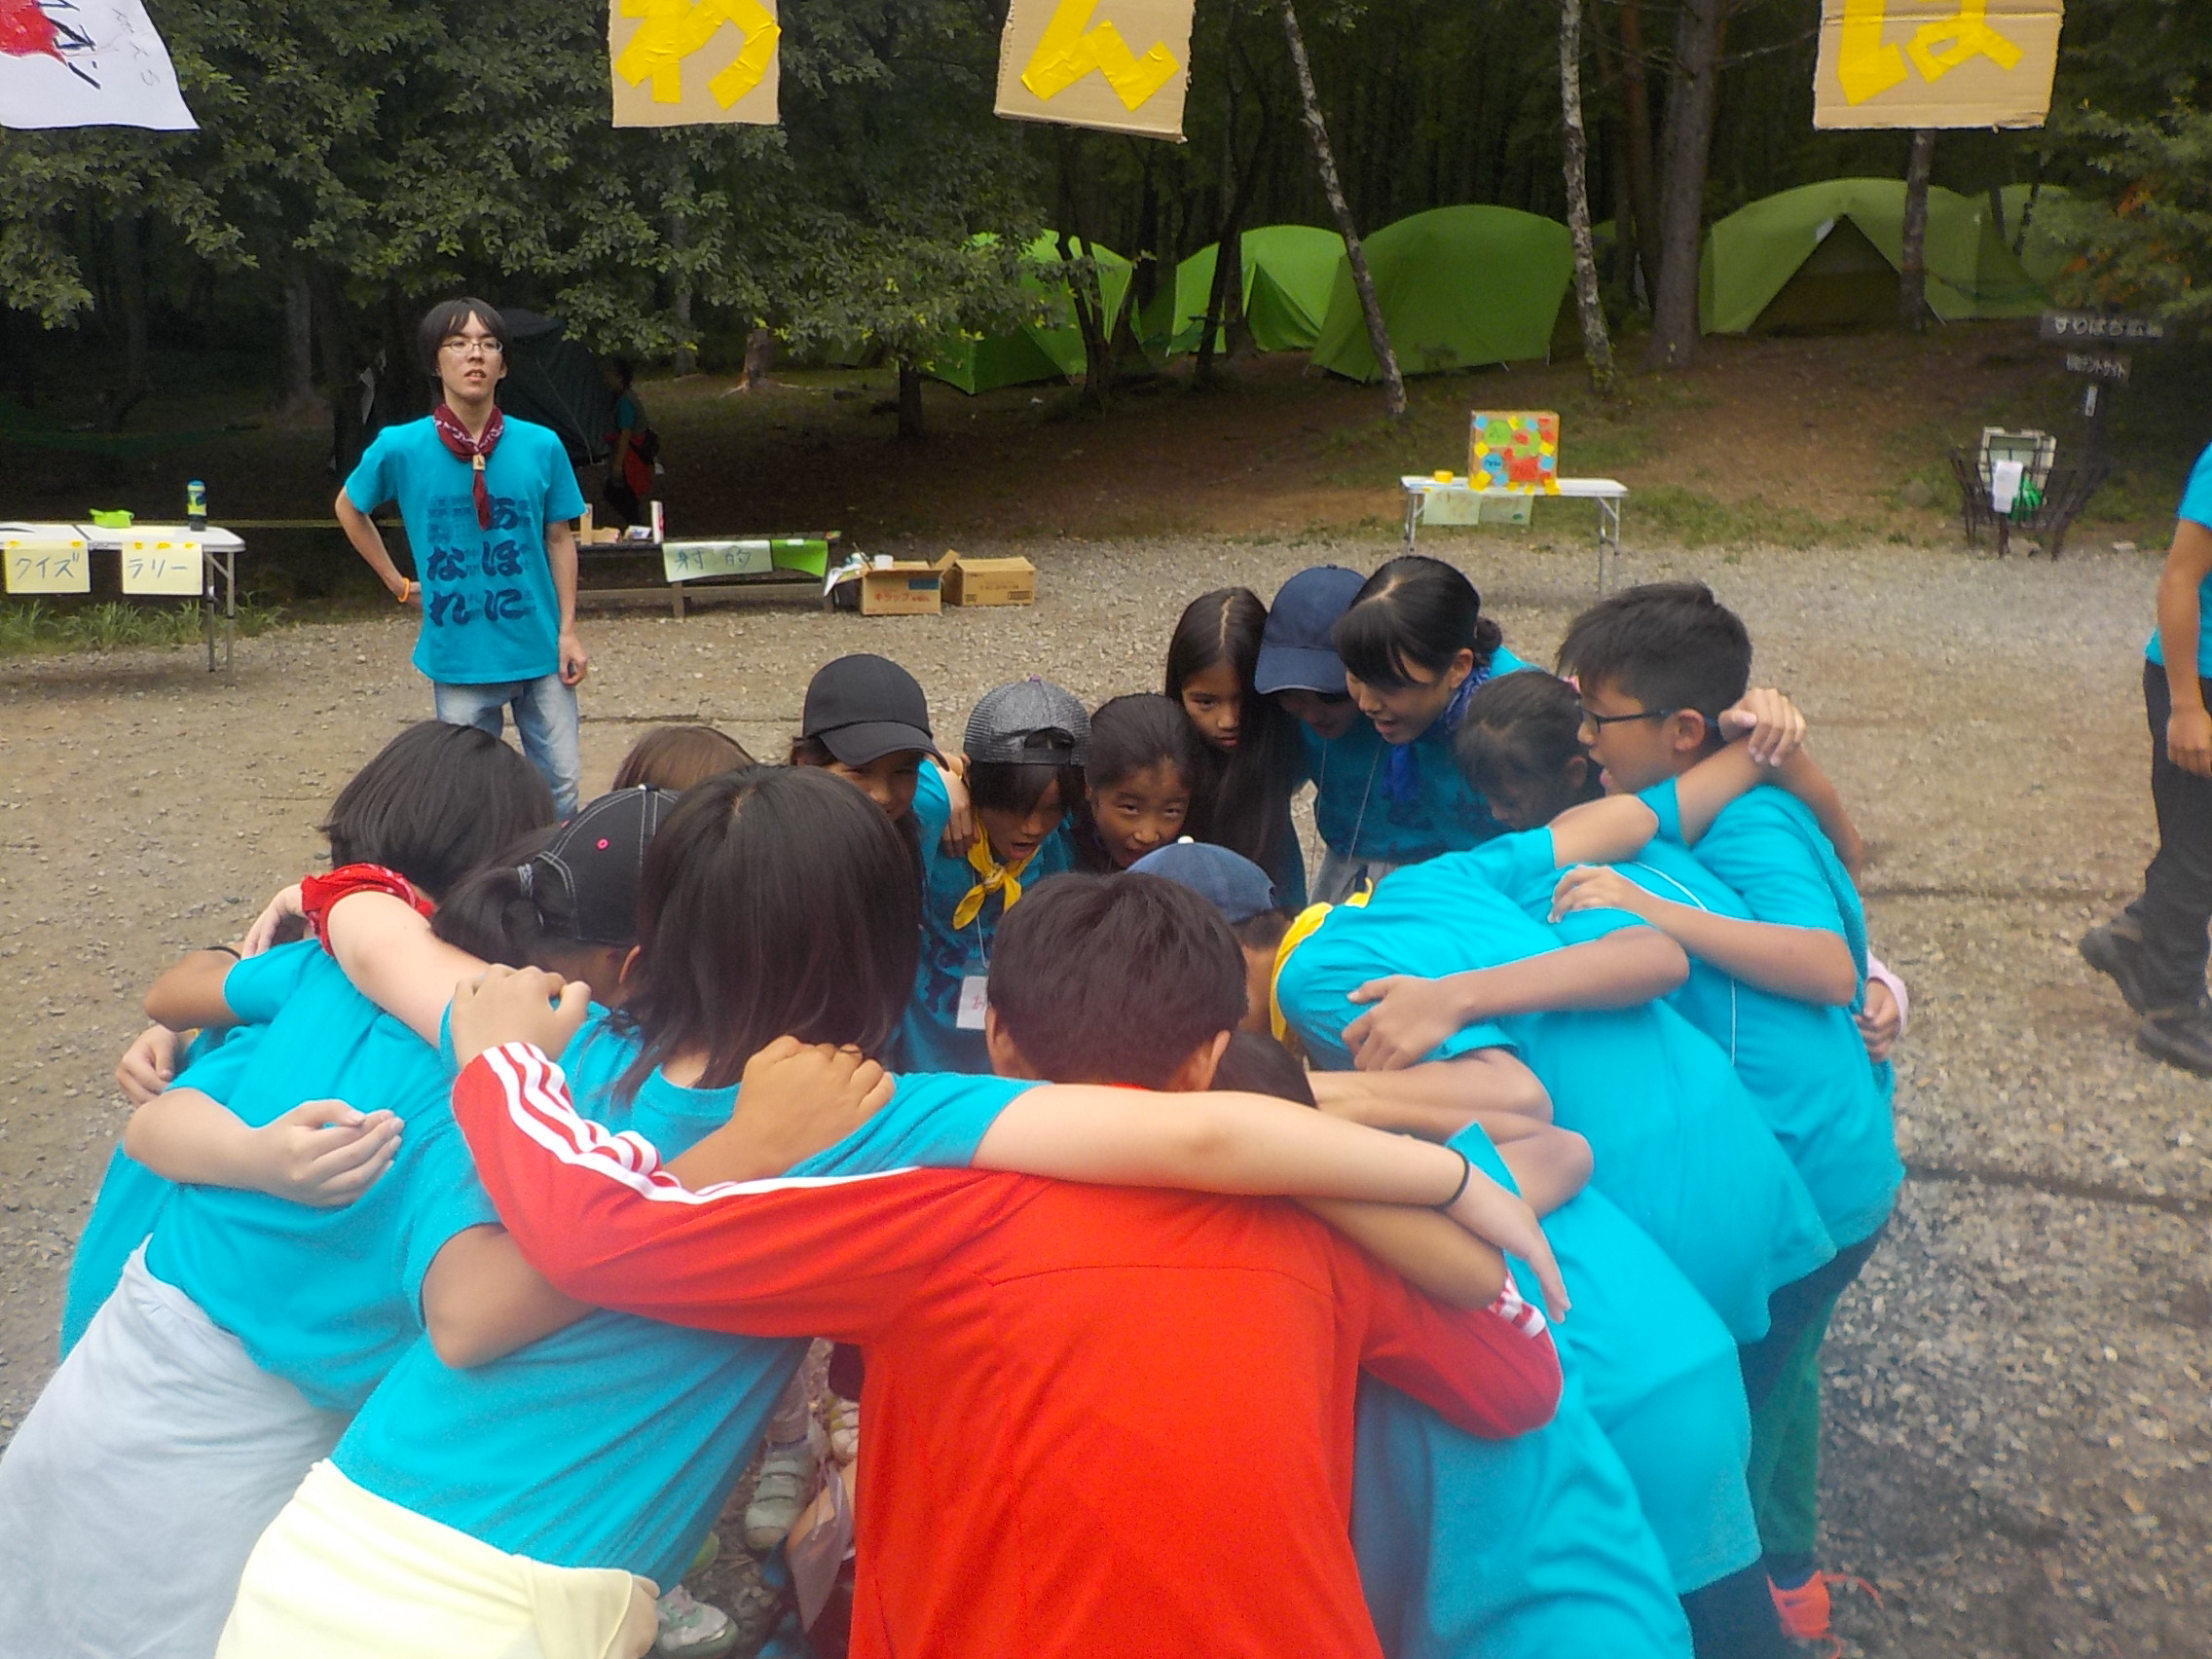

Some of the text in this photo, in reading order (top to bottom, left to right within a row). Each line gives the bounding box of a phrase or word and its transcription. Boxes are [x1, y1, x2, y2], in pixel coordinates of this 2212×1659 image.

[15, 552, 81, 580] クイズ
[127, 558, 188, 580] ラリー
